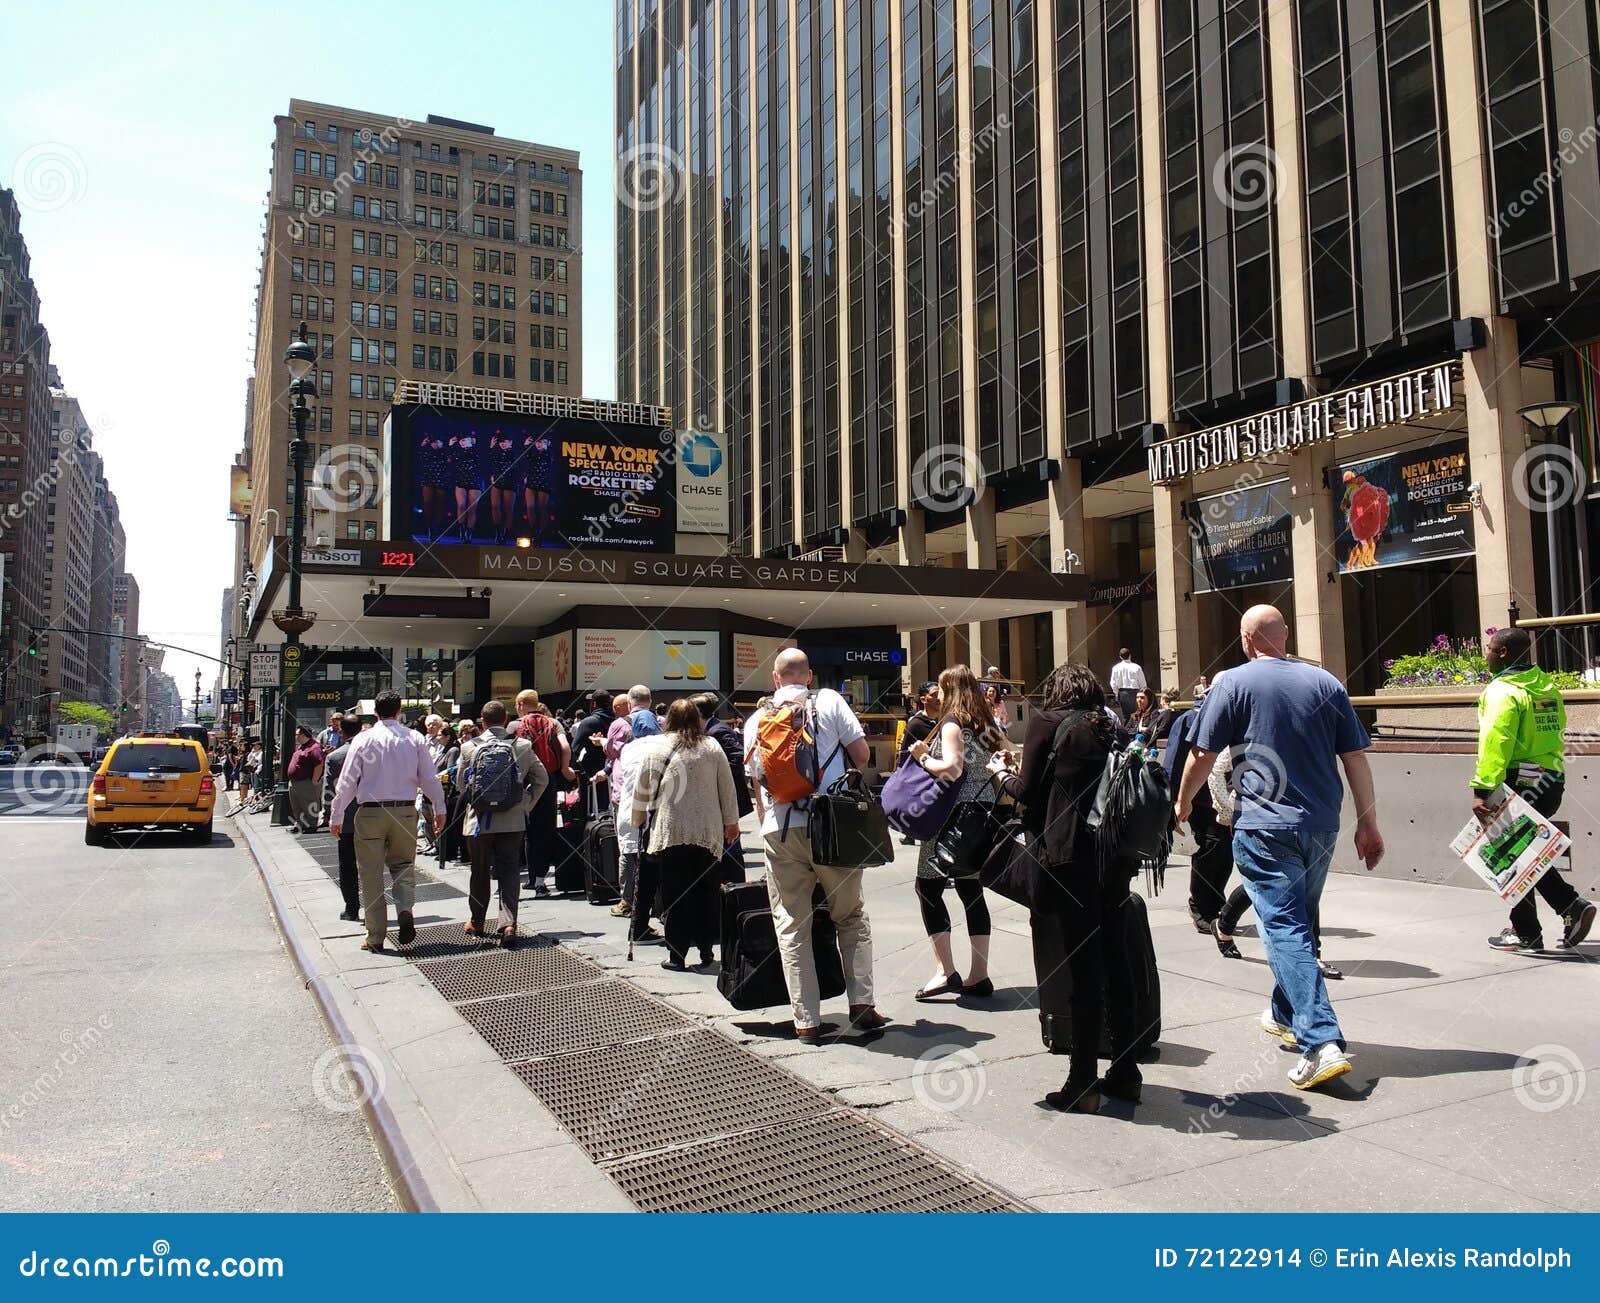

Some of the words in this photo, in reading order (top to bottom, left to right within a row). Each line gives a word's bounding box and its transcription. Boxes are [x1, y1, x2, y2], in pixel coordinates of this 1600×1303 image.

[418, 384, 505, 411] MADISON
[516, 392, 581, 418] SQUARE
[594, 399, 659, 426] GARDEN
[1148, 424, 1239, 482] MADISON
[1246, 397, 1334, 457] SQUARE
[1346, 365, 1452, 431] GARDEN
[562, 442, 606, 459] NEW
[611, 445, 659, 464] YORK
[569, 458, 653, 473] SPECTACULAR
[1401, 460, 1430, 479] NEW
[1432, 452, 1467, 470] YORK
[568, 474, 655, 491] ROCKETTES
[1407, 467, 1463, 486] SPECTACULAR
[682, 484, 723, 496] CHASE
[1407, 481, 1464, 501] ROCKETTES
[614, 516, 635, 524] August
[1213, 524, 1229, 533] Time
[1229, 518, 1252, 530] Warner
[1253, 514, 1273, 525] Cable
[1228, 535, 1256, 553] SQUARE
[1257, 530, 1287, 548] GARDEN
[310, 550, 361, 563] TISSOT
[381, 552, 415, 566] 12:21
[483, 554, 616, 574] MADISON
[633, 561, 741, 579] SQUARE
[757, 566, 857, 584] GARDEN
[253, 655, 277, 663] STOP
[846, 651, 889, 662] CHASE
